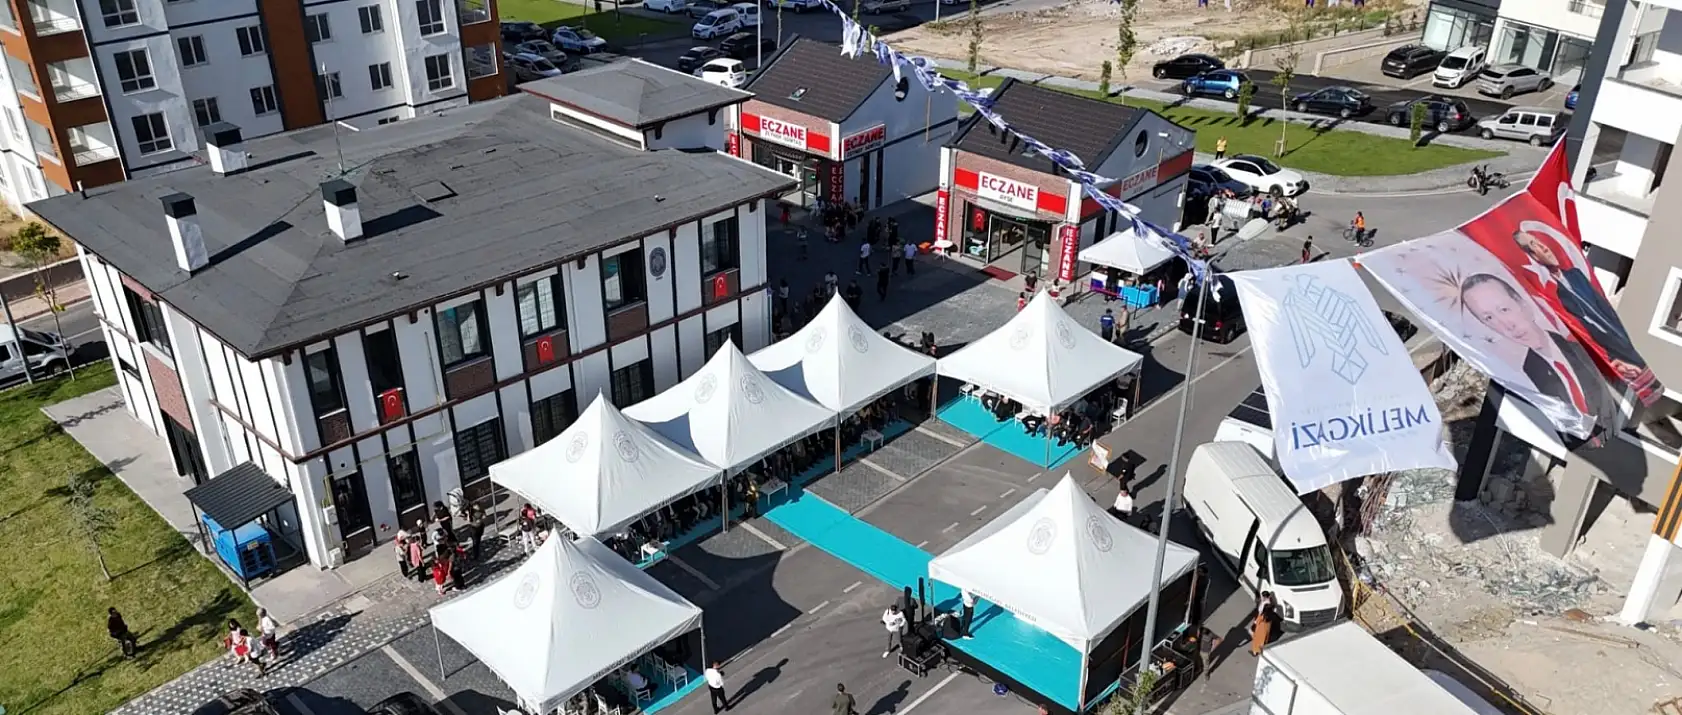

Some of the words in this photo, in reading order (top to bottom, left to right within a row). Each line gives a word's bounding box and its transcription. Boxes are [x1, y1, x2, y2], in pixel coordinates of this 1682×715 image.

[762, 119, 804, 140] ECZANE
[844, 128, 884, 151] ECZANE
[981, 175, 1034, 201] ECZANE
[1123, 168, 1156, 191] ECZANE
[1061, 228, 1074, 278] ECZANE
